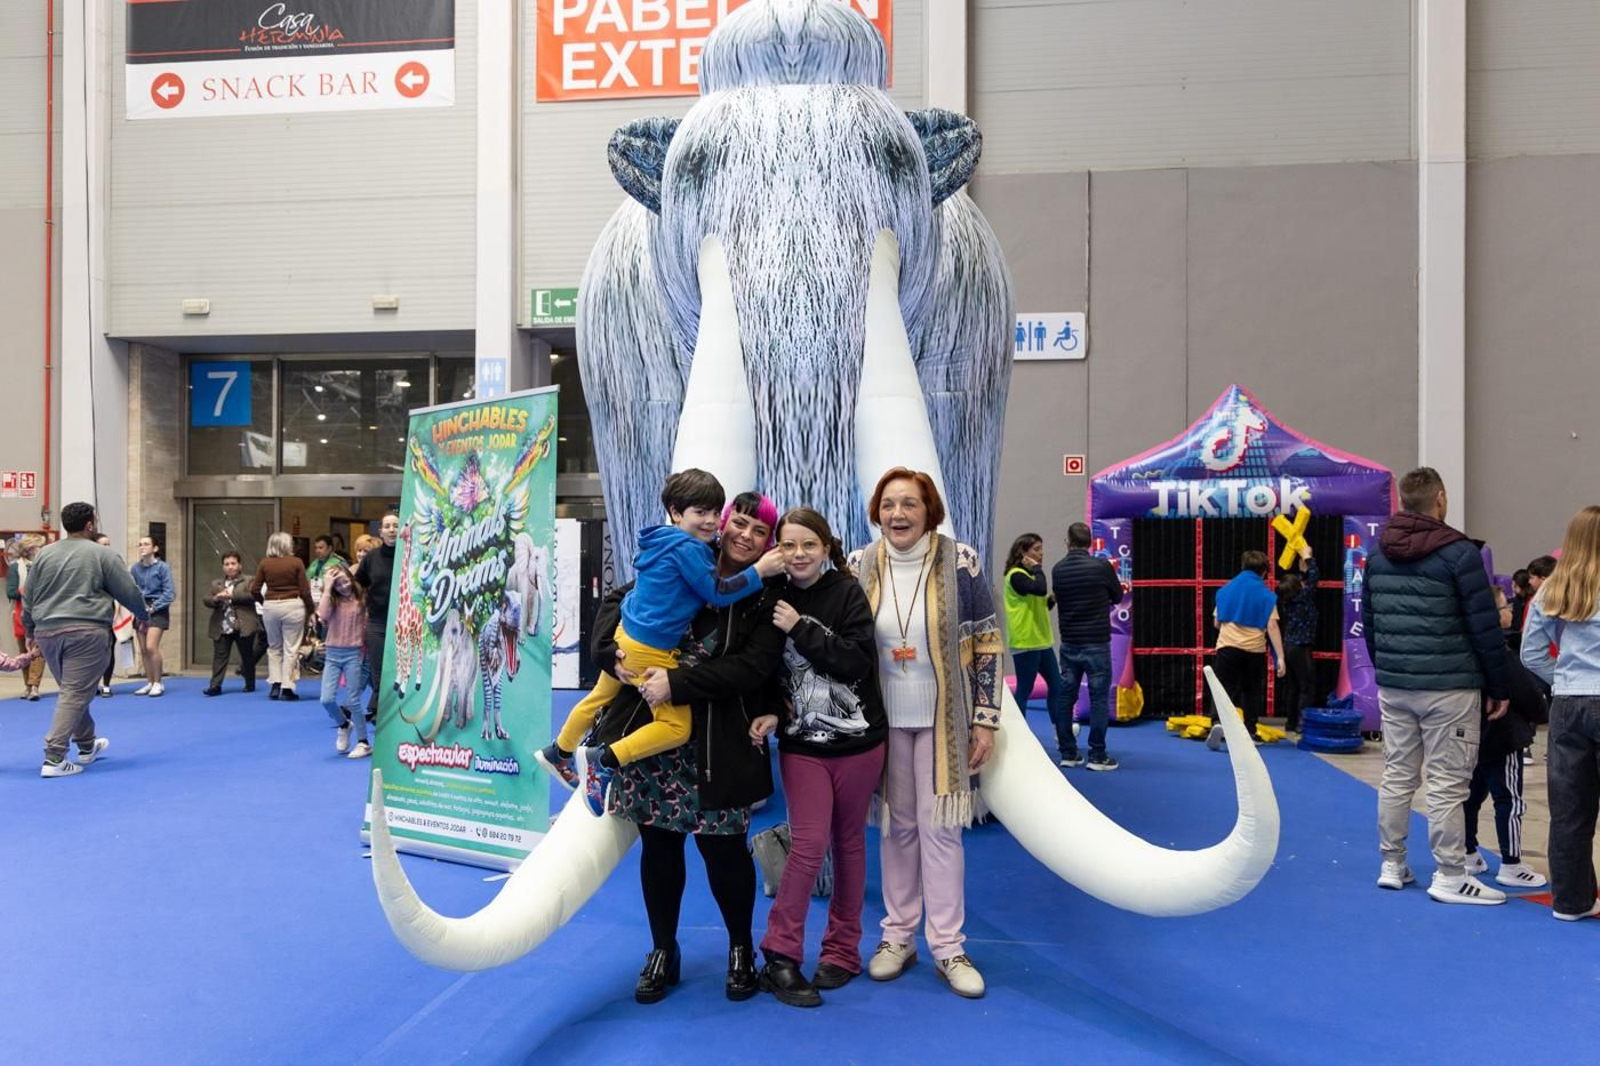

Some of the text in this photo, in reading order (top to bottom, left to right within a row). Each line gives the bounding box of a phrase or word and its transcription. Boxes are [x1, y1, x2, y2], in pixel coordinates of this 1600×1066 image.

[258, 2, 320, 37] Casa
[202, 71, 379, 101] SNACK BAR
[207, 370, 239, 418] 7
[432, 406, 530, 444] HINCHABLES
[446, 435, 485, 457] EVENTOS
[487, 432, 517, 453] JODAR
[1150, 478, 1311, 516] TikTok
[419, 493, 507, 579] Animals
[426, 549, 506, 624] Dreams
[474, 754, 519, 775] iluminación
